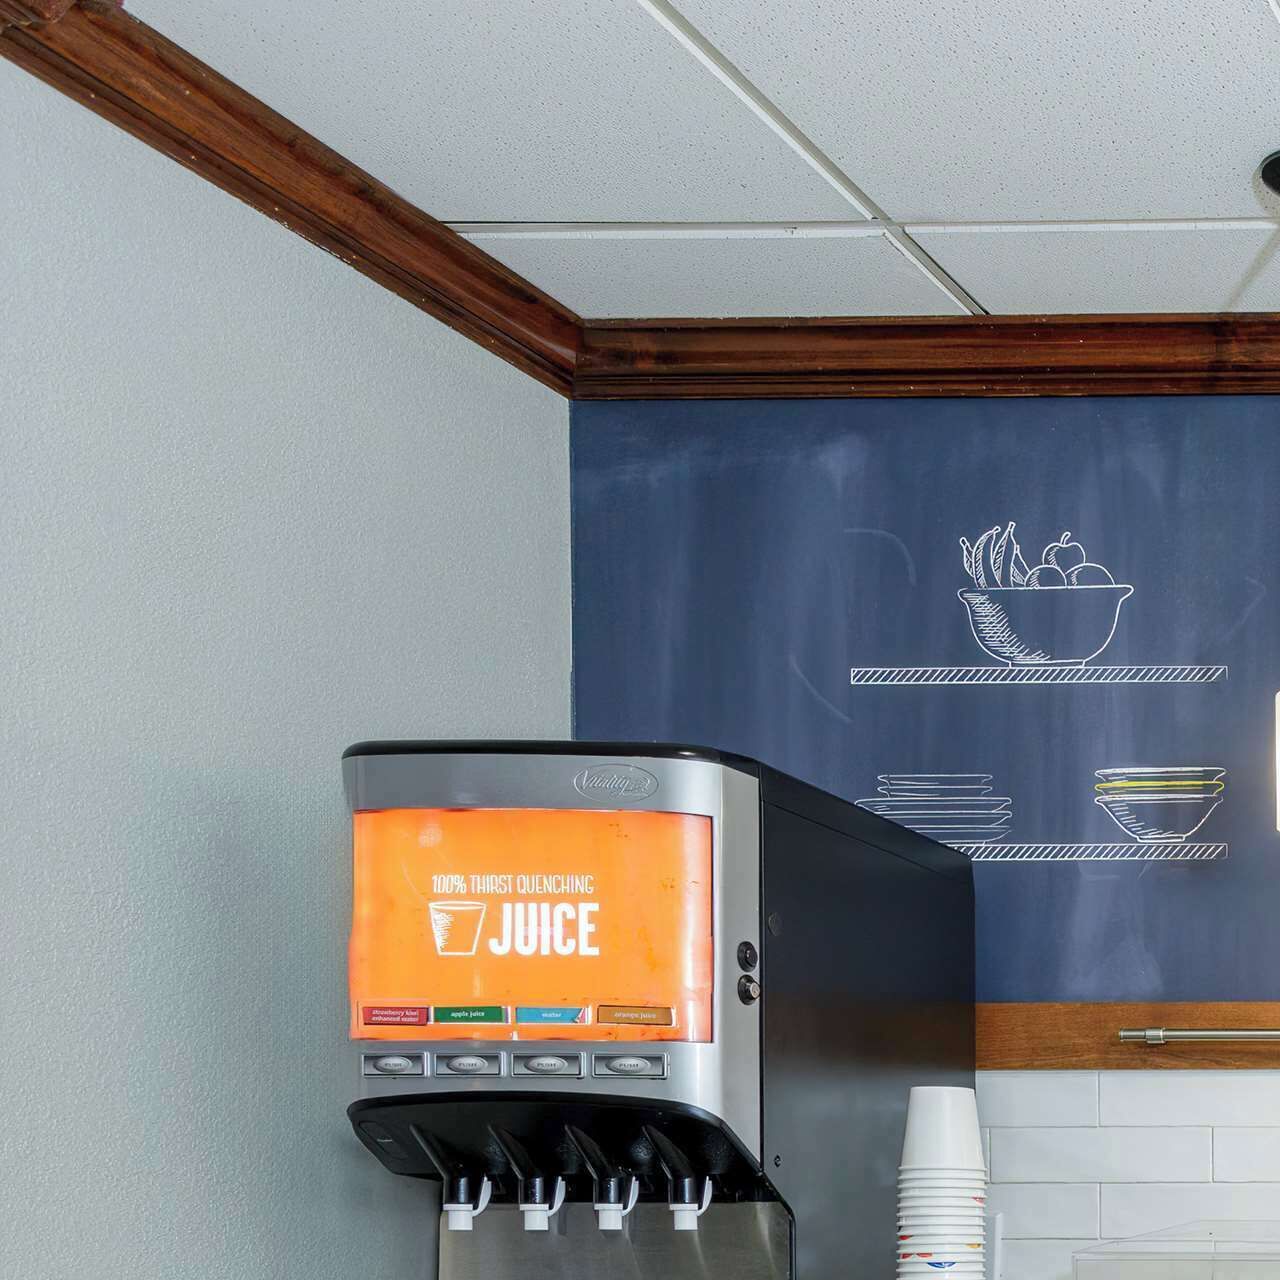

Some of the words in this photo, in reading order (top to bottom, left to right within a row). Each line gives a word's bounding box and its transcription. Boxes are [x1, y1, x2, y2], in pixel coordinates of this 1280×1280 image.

[432, 874, 467, 894] 100%
[470, 874, 514, 894] THIRST
[516, 874, 594, 895] QUENCHING
[488, 902, 600, 956] JUICE
[469, 1010, 485, 1018] juice
